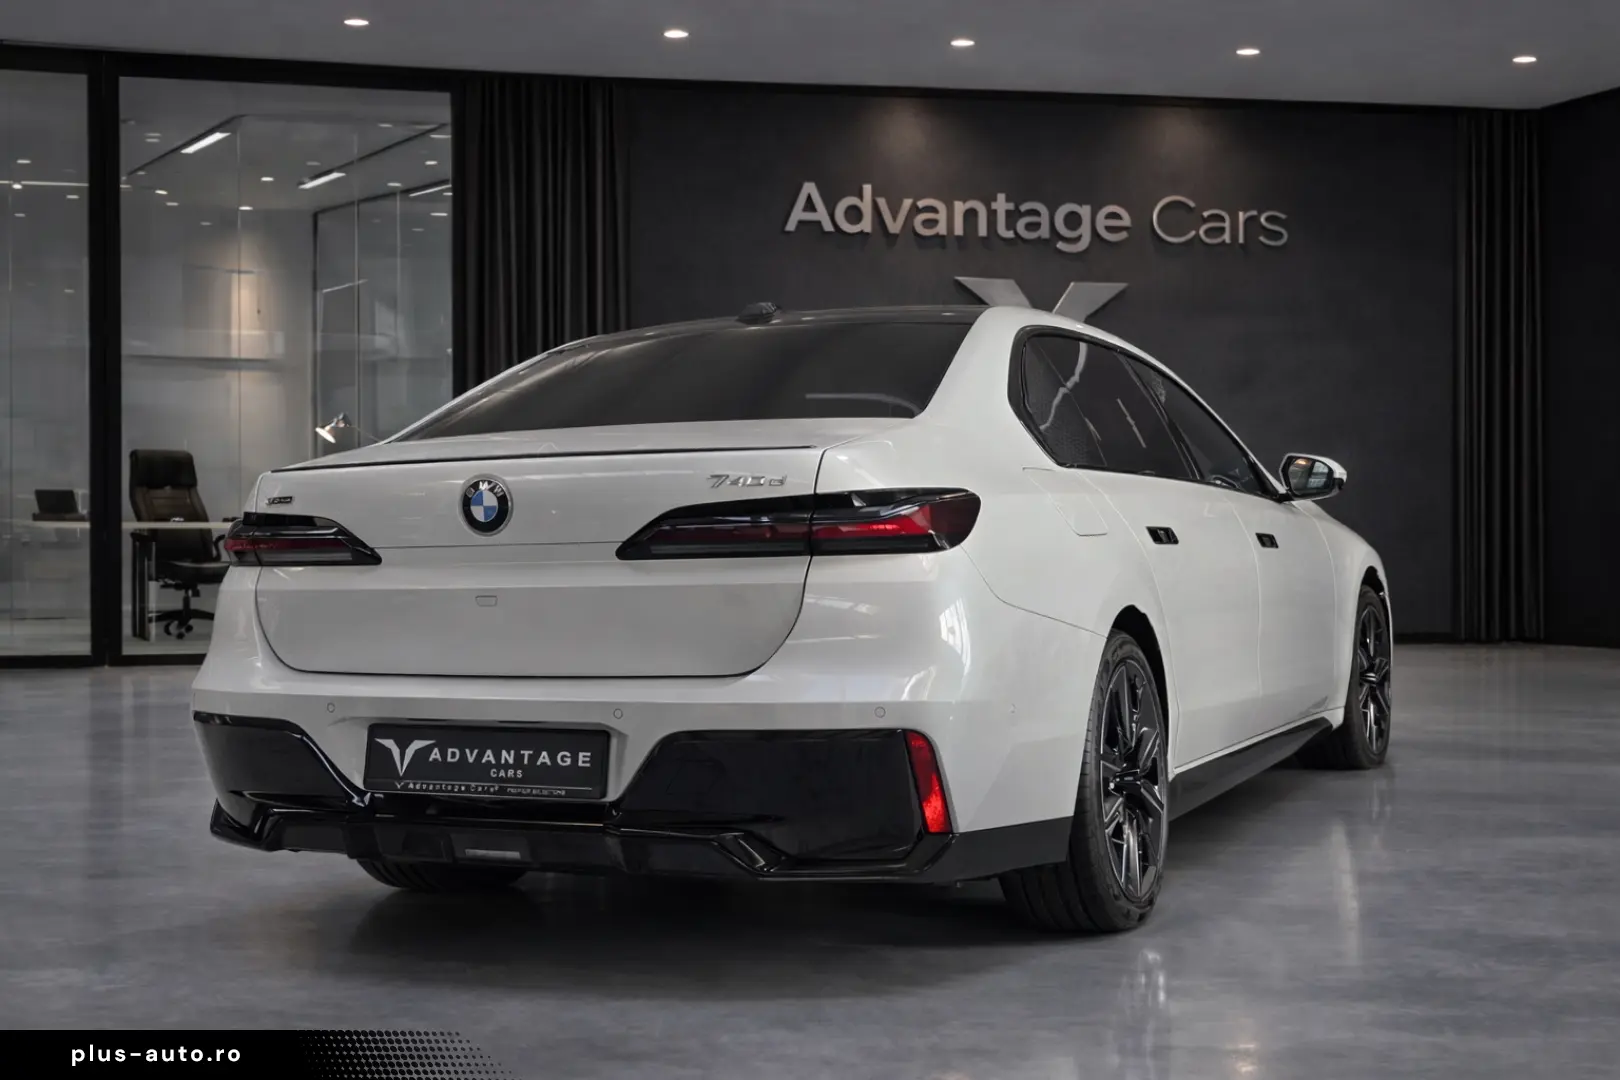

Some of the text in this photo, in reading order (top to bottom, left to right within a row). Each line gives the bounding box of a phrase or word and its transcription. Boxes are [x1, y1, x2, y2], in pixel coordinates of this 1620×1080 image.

[784, 181, 1289, 253] Advantage Cars
[465, 480, 505, 498] BMW
[707, 474, 788, 489] 740d
[428, 747, 592, 767] ADVANTAGE
[490, 768, 523, 778] CARS
